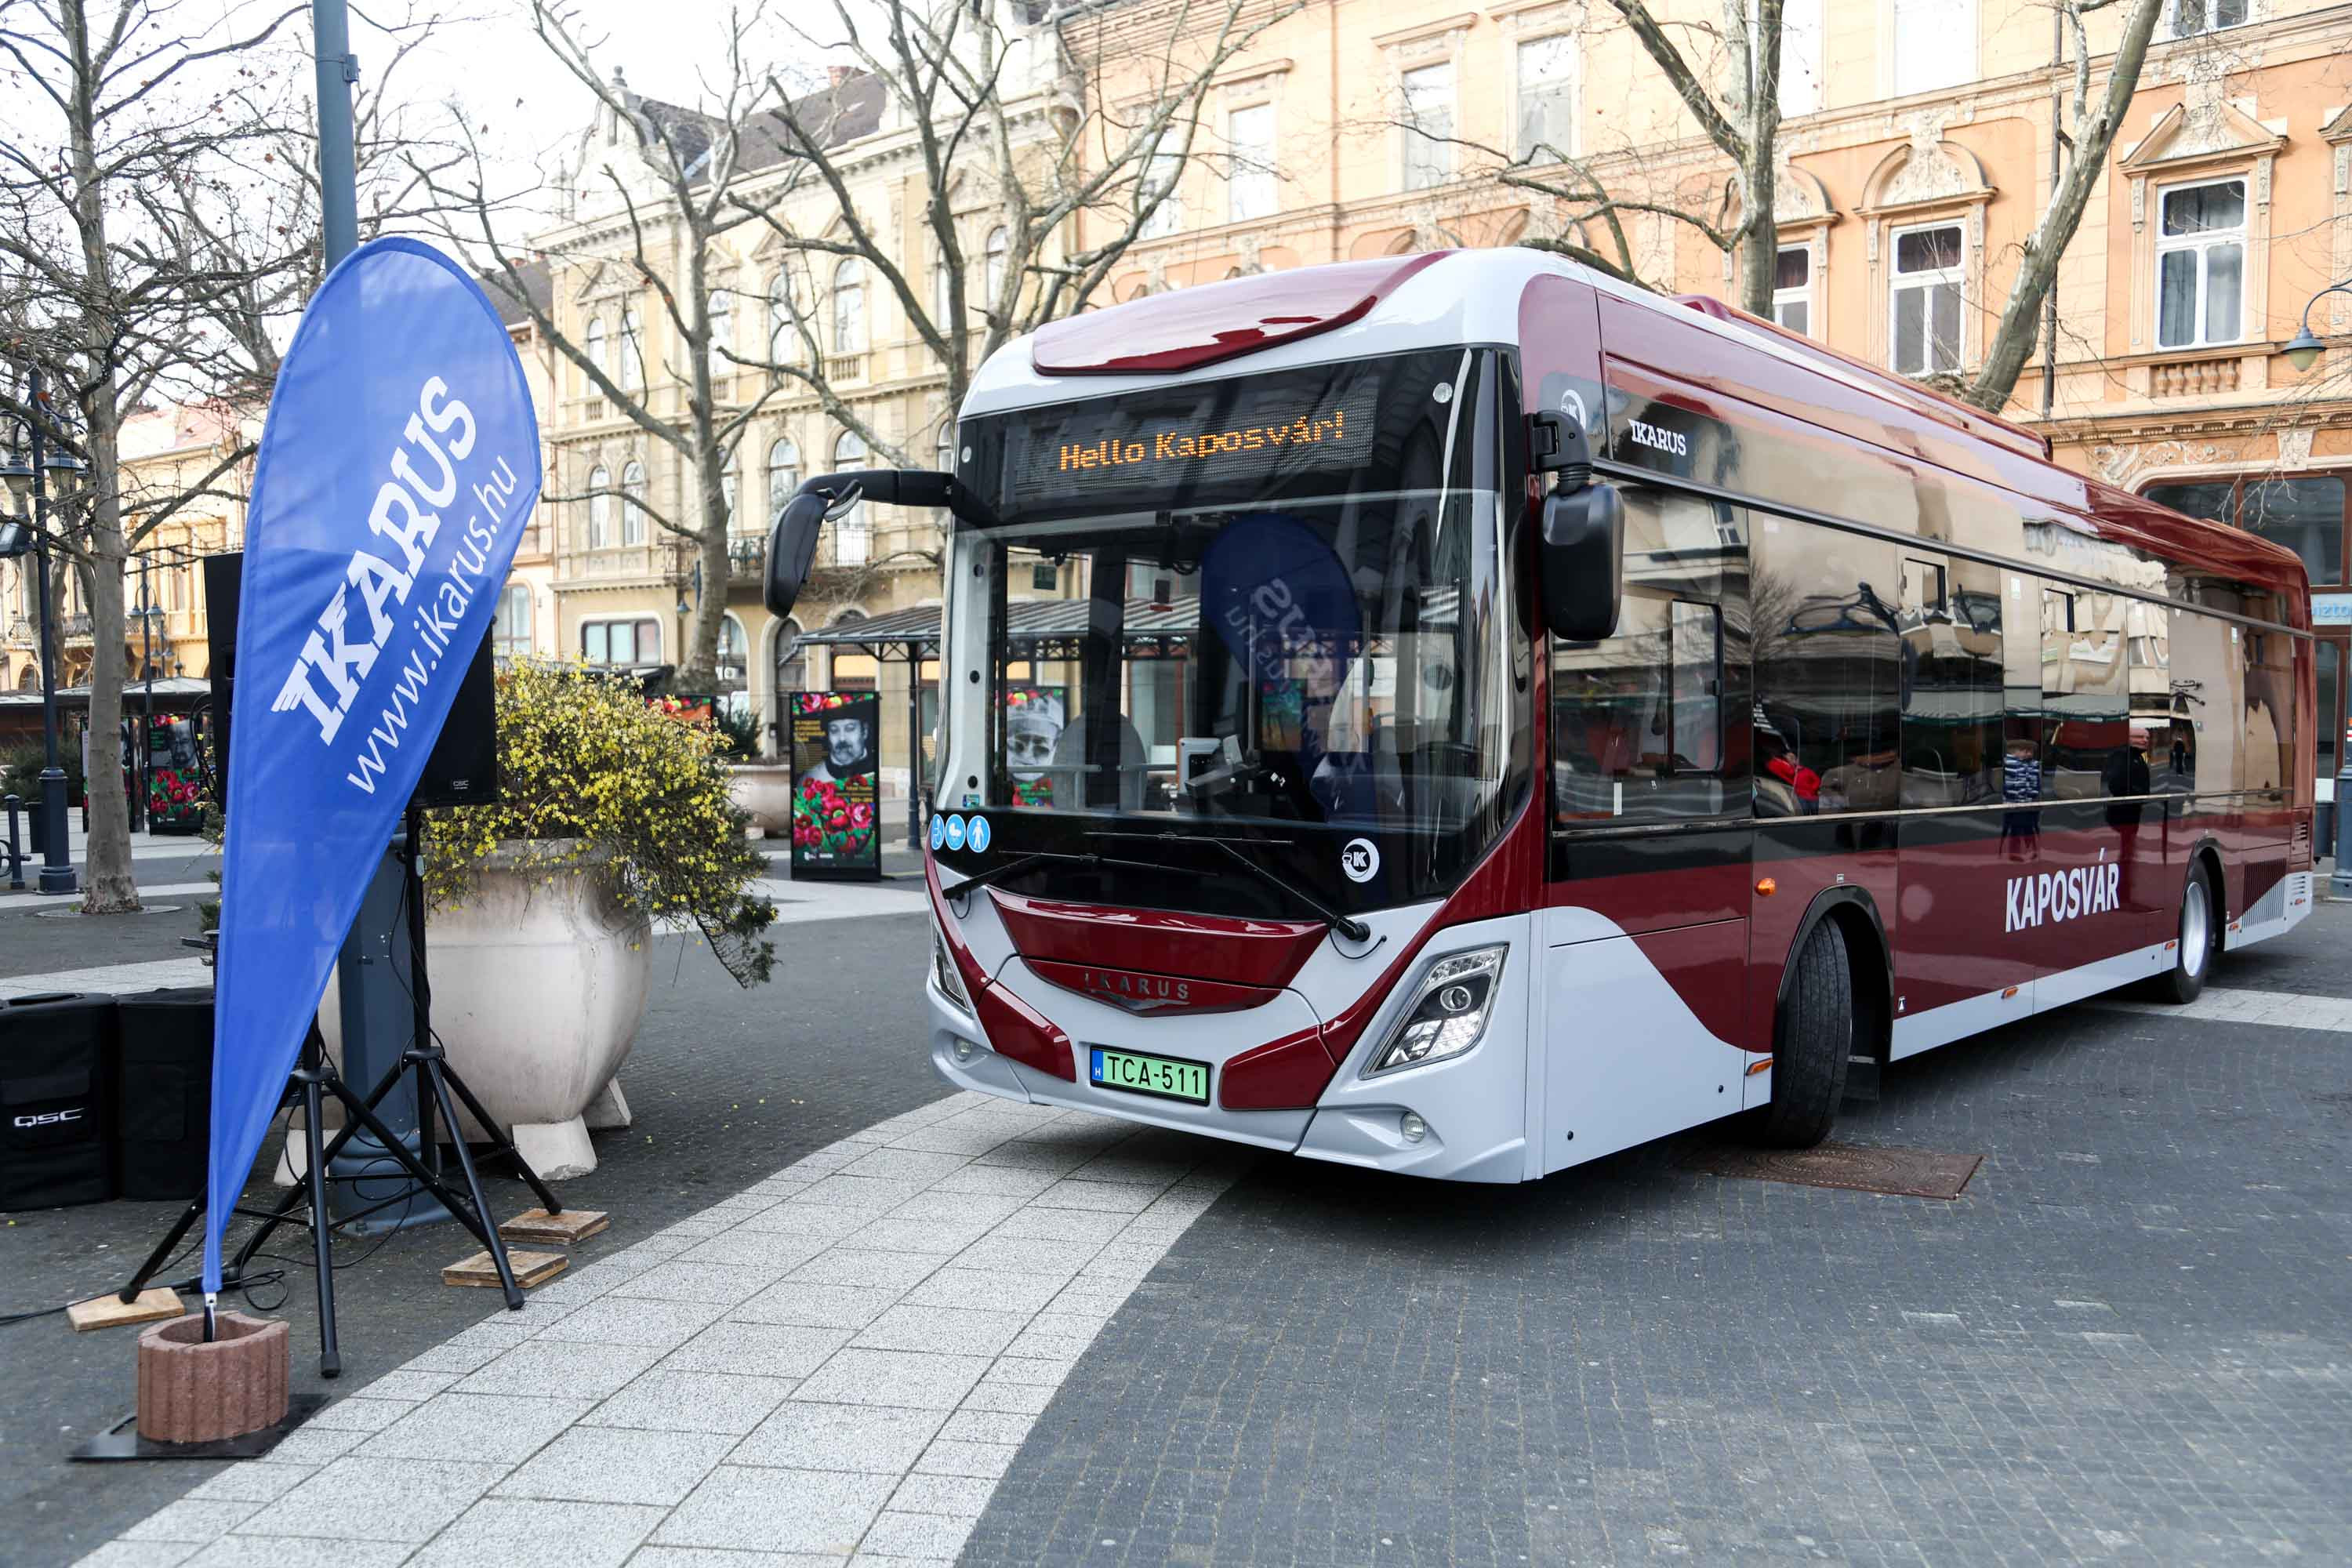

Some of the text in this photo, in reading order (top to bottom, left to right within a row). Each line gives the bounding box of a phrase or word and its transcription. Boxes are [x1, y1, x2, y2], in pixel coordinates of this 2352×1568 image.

[1060, 411, 1344, 470] Hello Kaposvár!
[1628, 419, 1687, 456] IKARUS
[271, 376, 476, 746] IKARUS
[347, 456, 517, 794] www.ikarus.hu
[2005, 848, 2120, 933] KAPOSVÁR
[1084, 972, 1189, 1000] IKARUS
[1094, 1067, 1102, 1076] H
[1107, 1055, 1199, 1094] TCA-511
[14, 1107, 85, 1127] QSC
